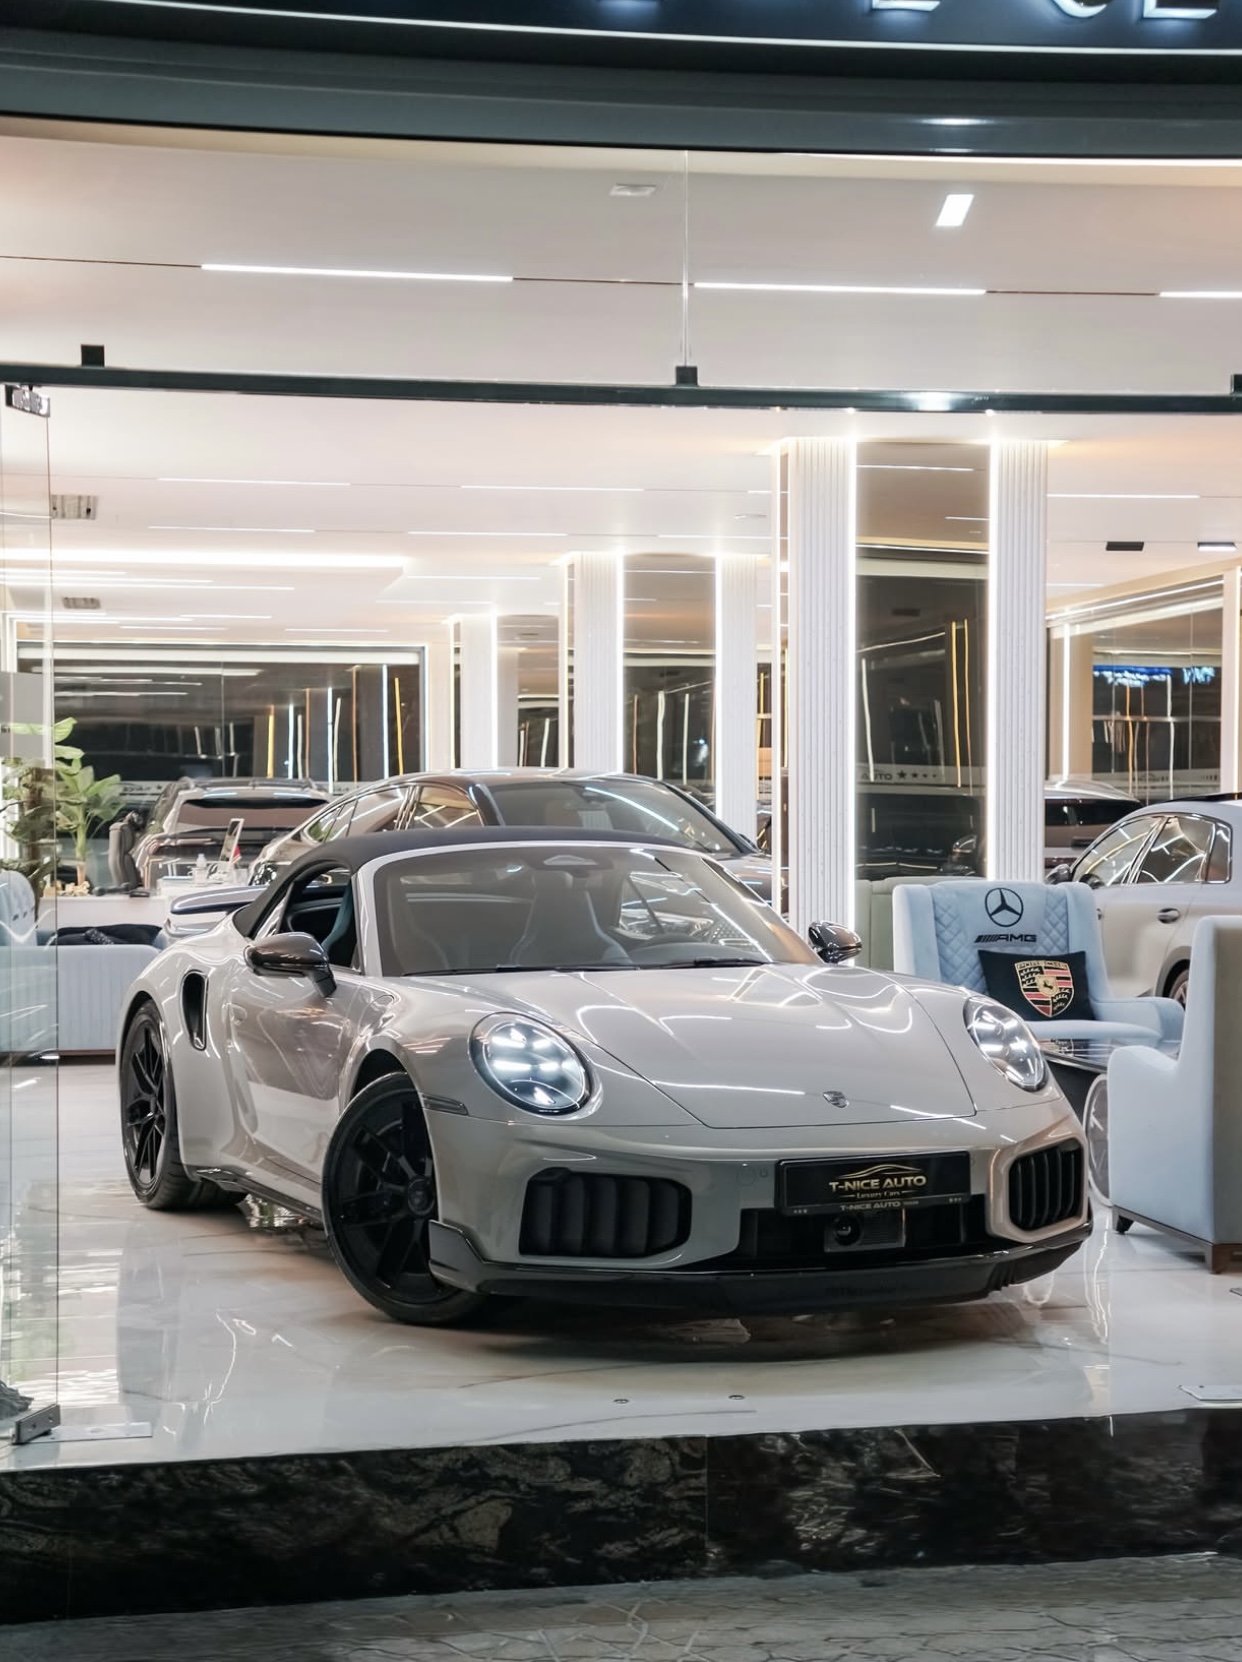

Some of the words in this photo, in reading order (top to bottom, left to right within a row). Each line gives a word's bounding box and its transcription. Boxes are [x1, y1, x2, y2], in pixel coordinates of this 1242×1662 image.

[993, 933, 1037, 943] AMG
[829, 1180, 880, 1193] T-NICE
[882, 1175, 927, 1189] AUTO
[856, 1191, 882, 1199] Luxury
[884, 1190, 901, 1198] Cars
[840, 1202, 872, 1211] T-NICE
[873, 1200, 901, 1209] AUTO
